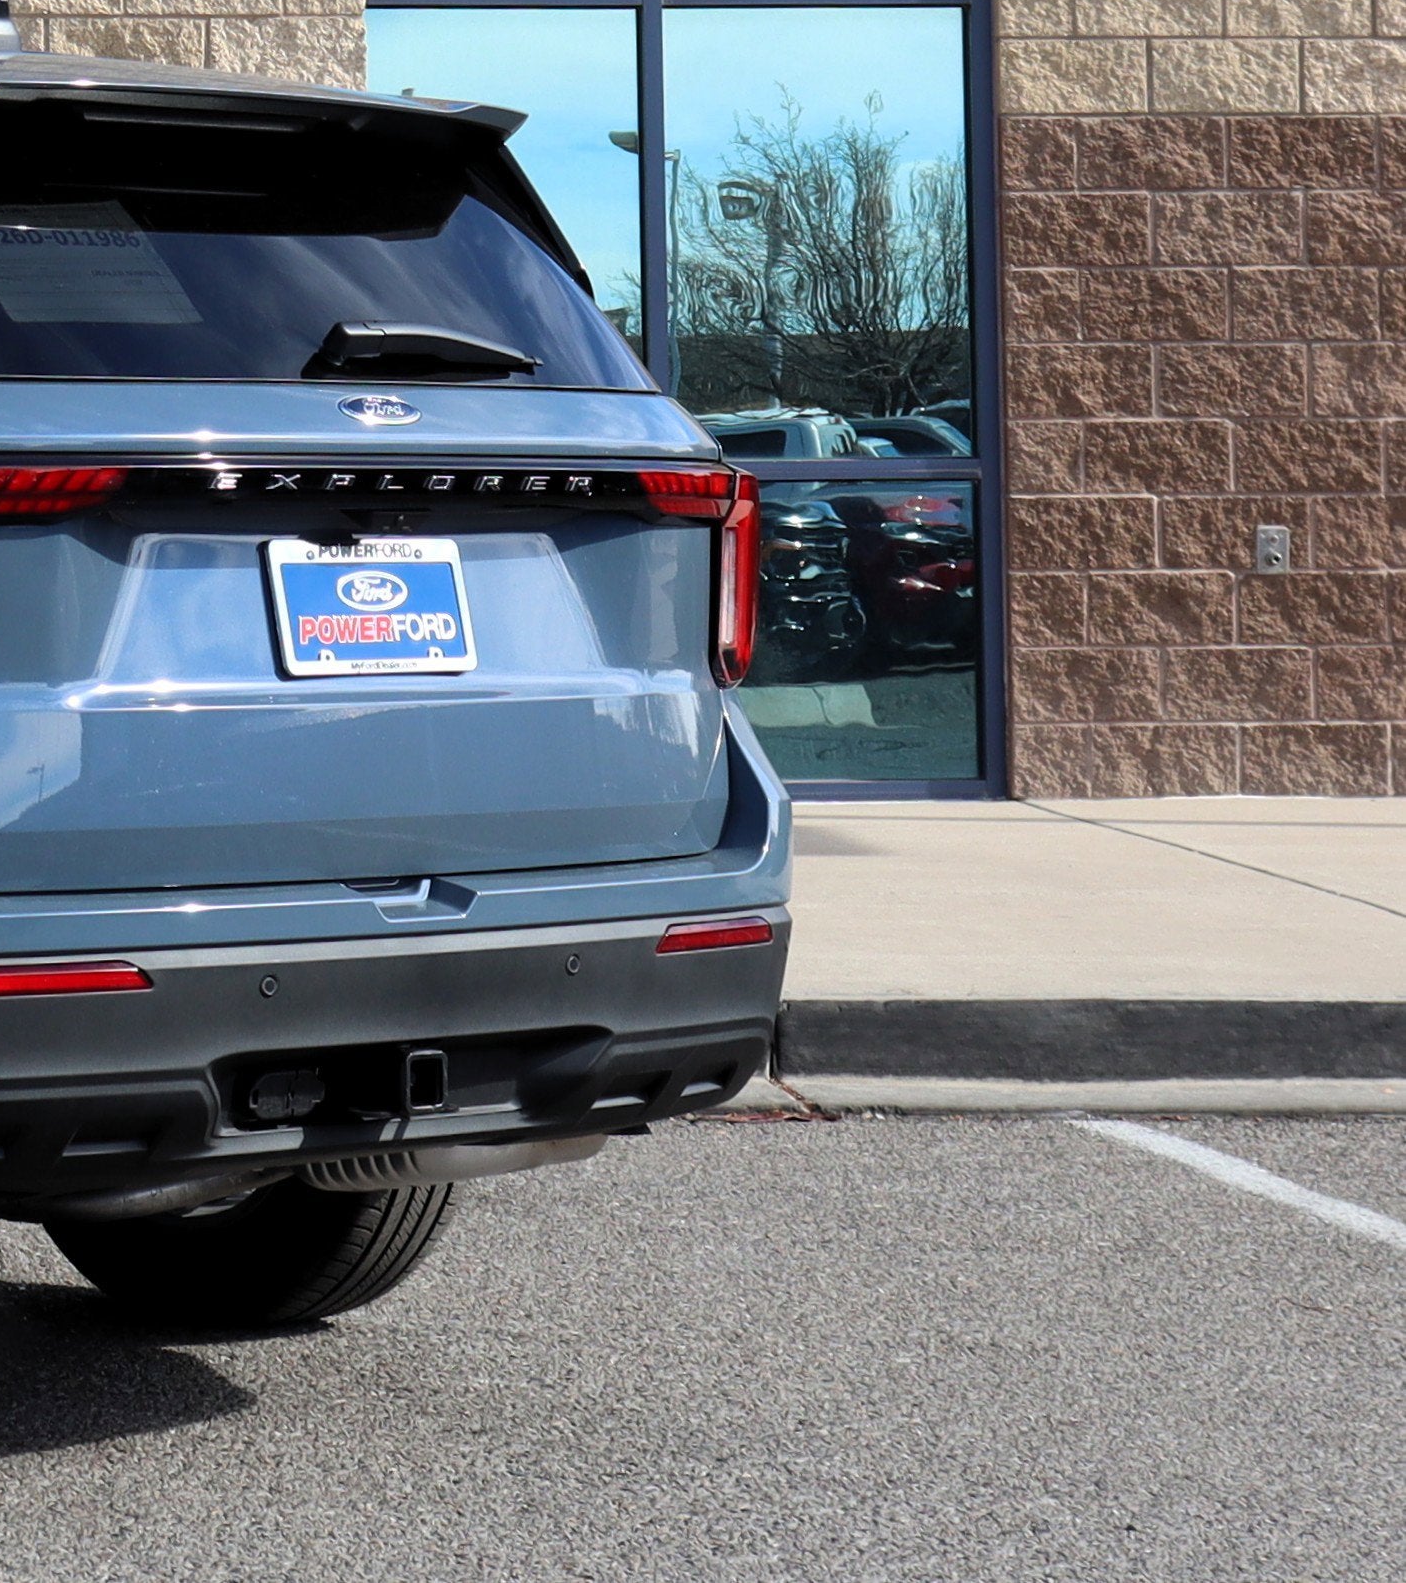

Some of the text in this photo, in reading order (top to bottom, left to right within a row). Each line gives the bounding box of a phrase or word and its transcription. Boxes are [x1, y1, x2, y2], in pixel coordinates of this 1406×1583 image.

[209, 472, 595, 495] EXPLORER
[318, 543, 412, 558] POWERFORD
[351, 578, 395, 603] Ford
[298, 612, 458, 645] POWERFORD
